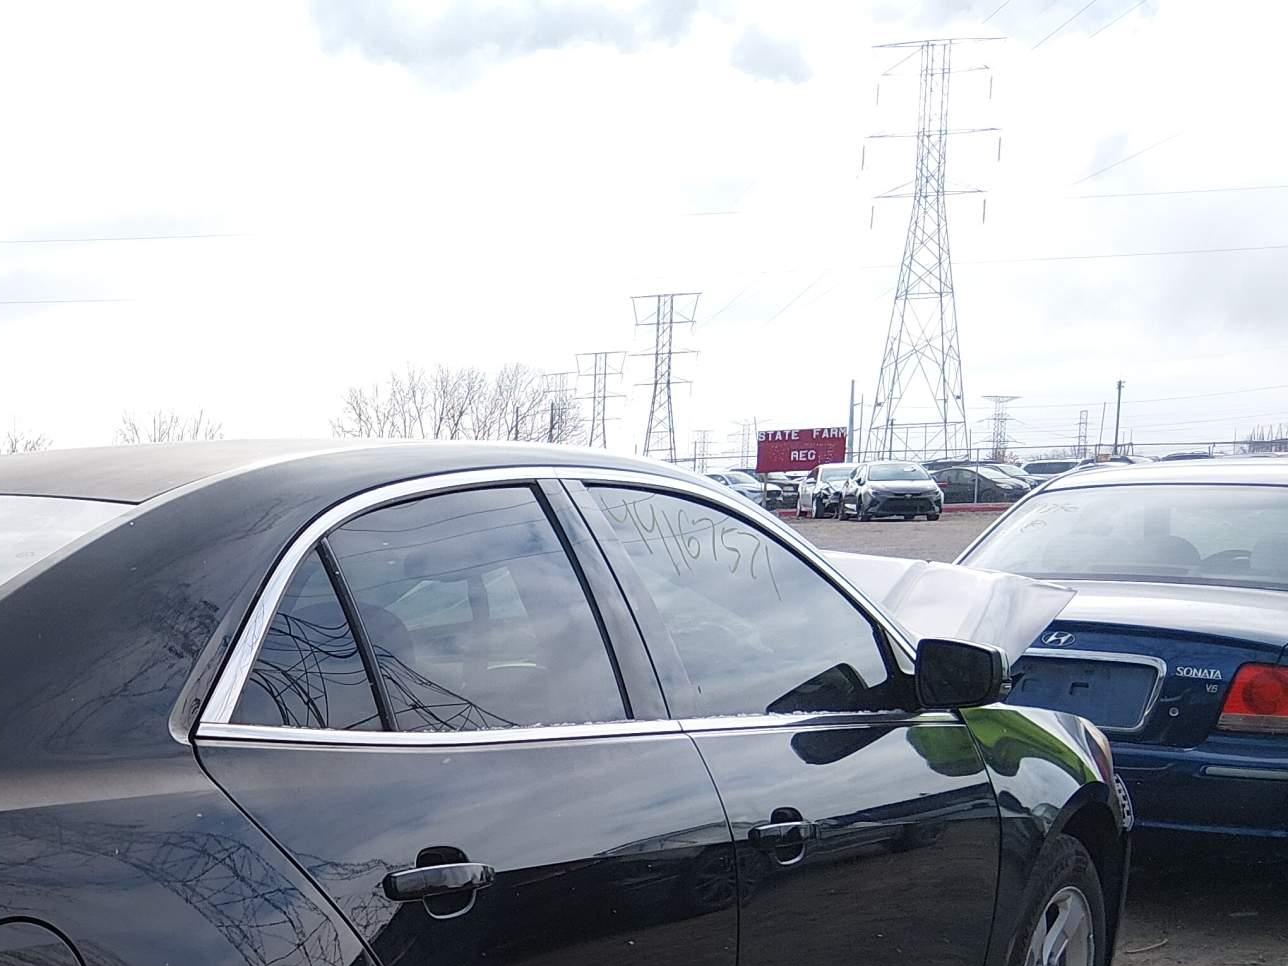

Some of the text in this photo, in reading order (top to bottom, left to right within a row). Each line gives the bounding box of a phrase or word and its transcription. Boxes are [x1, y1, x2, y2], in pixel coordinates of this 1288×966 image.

[758, 427, 847, 441] STATE FARM
[1175, 666, 1222, 680] SONATA
[1206, 684, 1219, 693] V6
